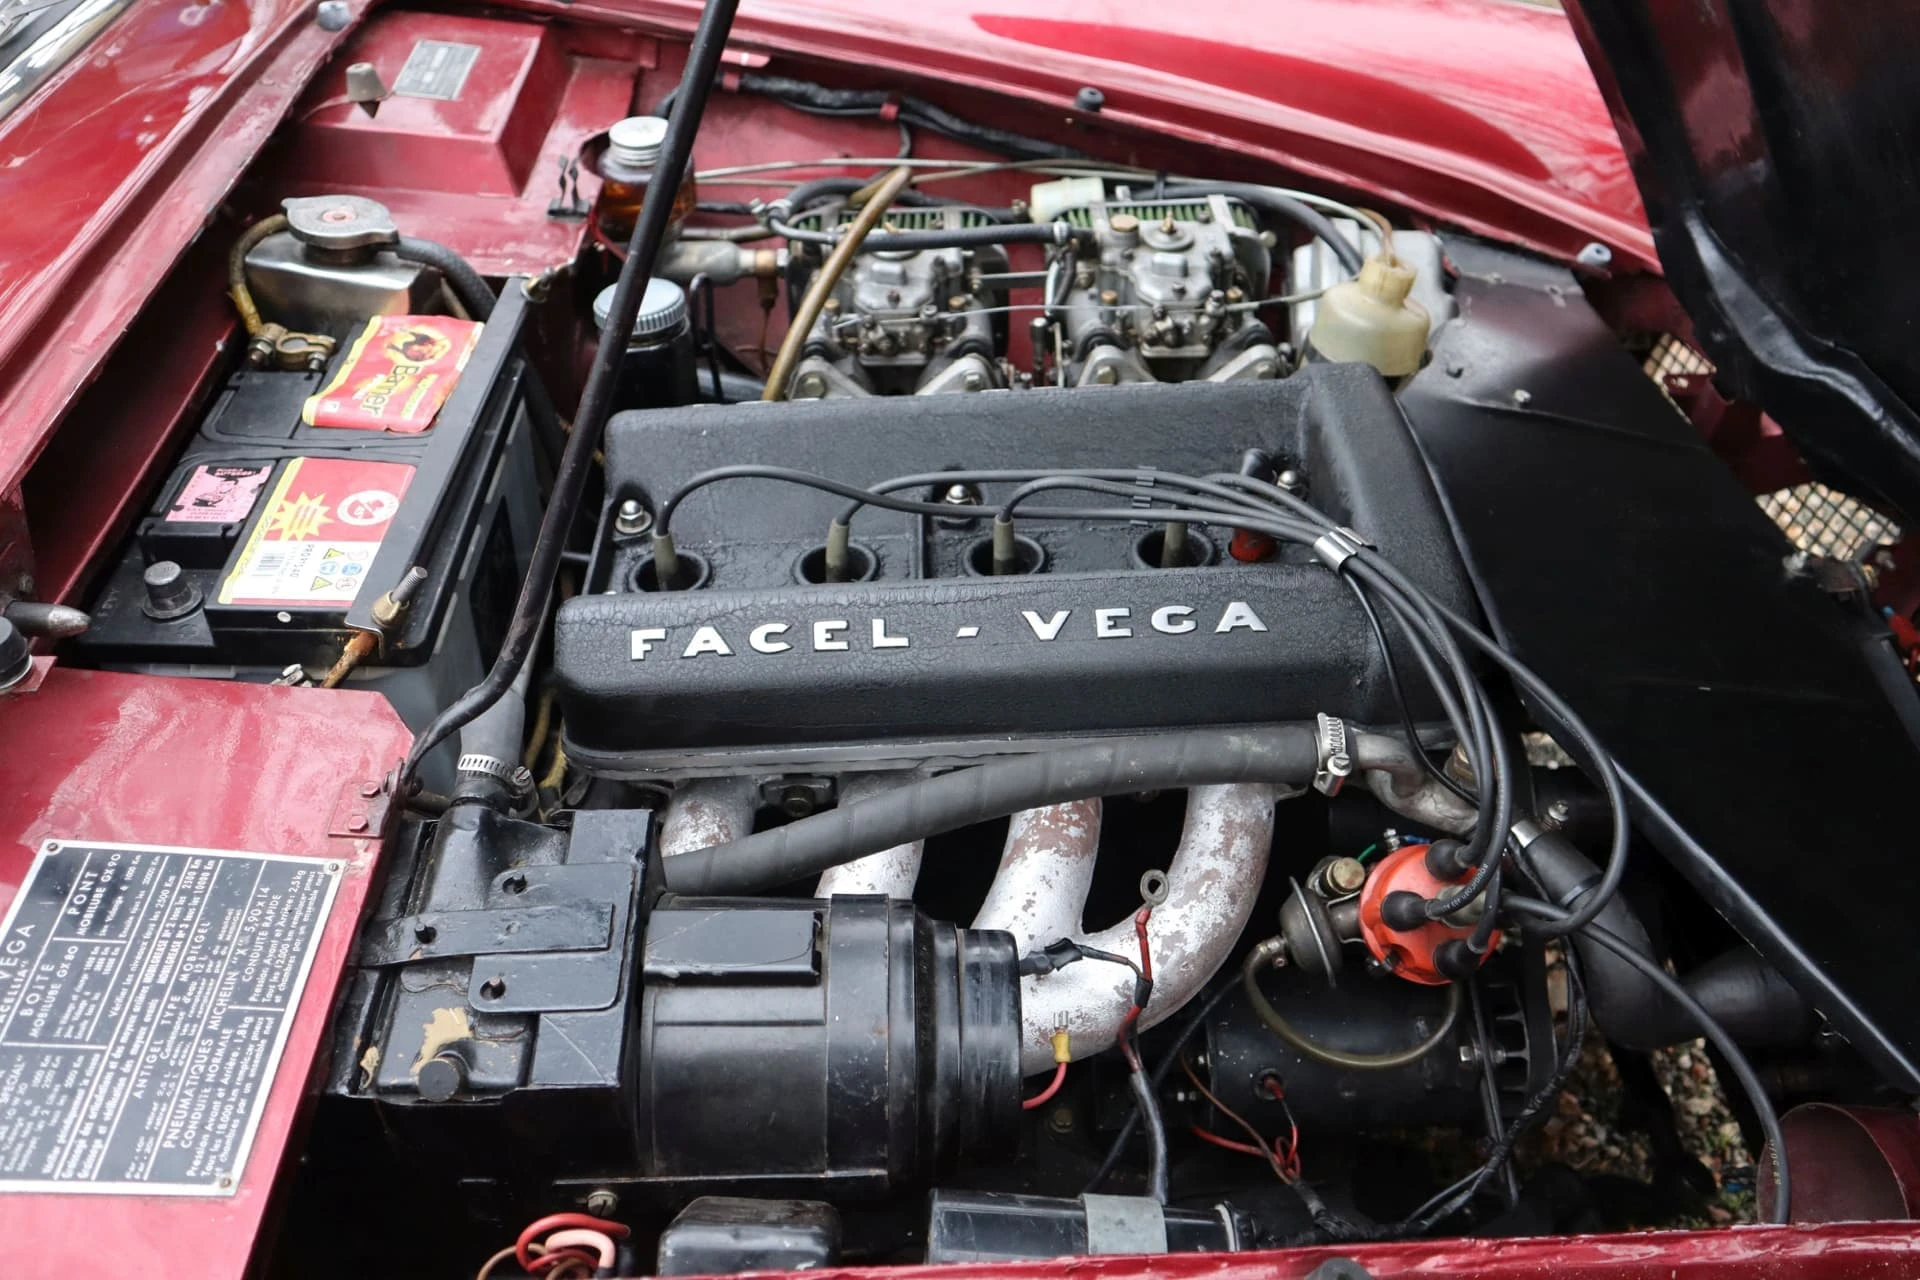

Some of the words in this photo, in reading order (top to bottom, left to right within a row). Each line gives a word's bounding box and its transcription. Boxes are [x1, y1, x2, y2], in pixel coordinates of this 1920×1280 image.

[629, 617, 911, 662] FACEL
[1022, 600, 1269, 642] VEGA
[181, 871, 197, 889] 2500
[190, 859, 202, 869] Km
[203, 859, 215, 870] Km
[303, 871, 316, 891] pneus
[66, 871, 98, 915] PONT
[76, 887, 106, 936] MOBILUBE
[290, 892, 307, 929] remplacer
[302, 889, 319, 922] ensemble
[0, 924, 36, 980] VEGA
[241, 930, 269, 982] CONDUITE
[261, 894, 282, 928] RAPIDE
[283, 929, 295, 942] km
[292, 938, 303, 952] par
[298, 925, 307, 936] un
[248, 967, 270, 1002] Pression
[262, 939, 279, 966] Avant
[261, 984, 276, 1003] Tous
[268, 971, 281, 983] les
[277, 955, 296, 992] chambres
[29, 983, 62, 1038] MOBILUBE
[132, 1039, 164, 1099] ANTIGEL
[160, 995, 181, 1025] TYPE
[179, 922, 211, 982] MOBILGEL
[159, 1011, 186, 1060] Contenance
[162, 1038, 214, 1149] PNEUMATIQUES
[207, 971, 239, 1031] MICHELIN
[180, 1087, 212, 1149] CONDUITE
[205, 1028, 233, 1083] NORMALE
[200, 1155, 217, 1177] Tous
[209, 1138, 223, 1152] les
[227, 1088, 240, 1102] km
[235, 1043, 255, 1086] remplacer
[250, 1016, 265, 1041] pneus
[218, 1118, 240, 1163] chambres
[236, 1098, 247, 1115] par
[243, 1082, 253, 1094] un
[248, 1039, 267, 1078] ensemble
[263, 1016, 275, 1035] neuf
[185, 1134, 210, 1177] Pression
[204, 1100, 222, 1132] Avant
